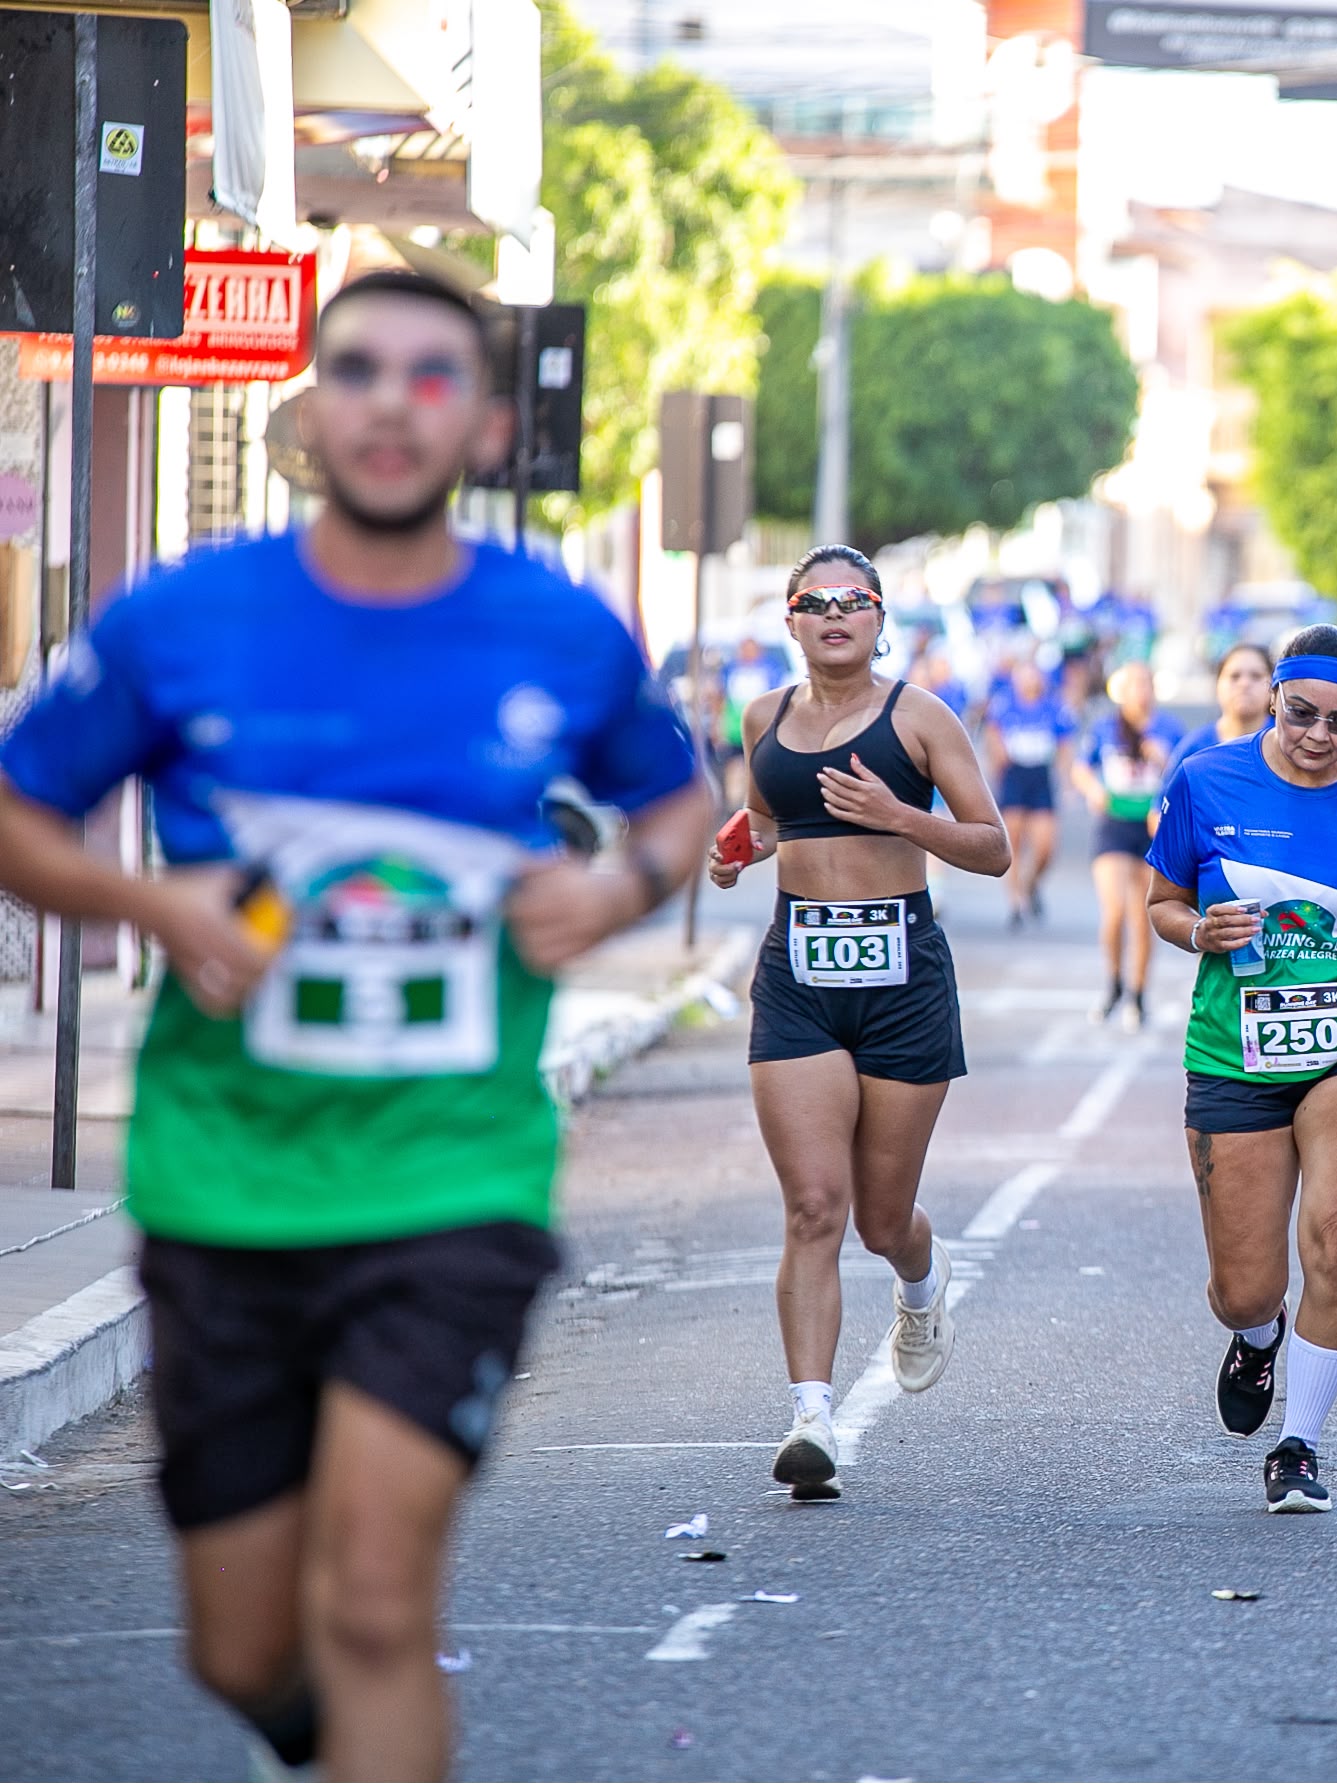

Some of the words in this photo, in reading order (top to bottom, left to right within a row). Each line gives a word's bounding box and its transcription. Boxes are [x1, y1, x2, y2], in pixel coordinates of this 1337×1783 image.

[184, 277, 291, 322] ZERRA
[869, 909, 888, 920] 3K
[1263, 933, 1316, 948] NNING
[811, 936, 886, 969] 103
[1264, 949, 1296, 960] ARZEA
[1297, 950, 1337, 961] ALEGRE
